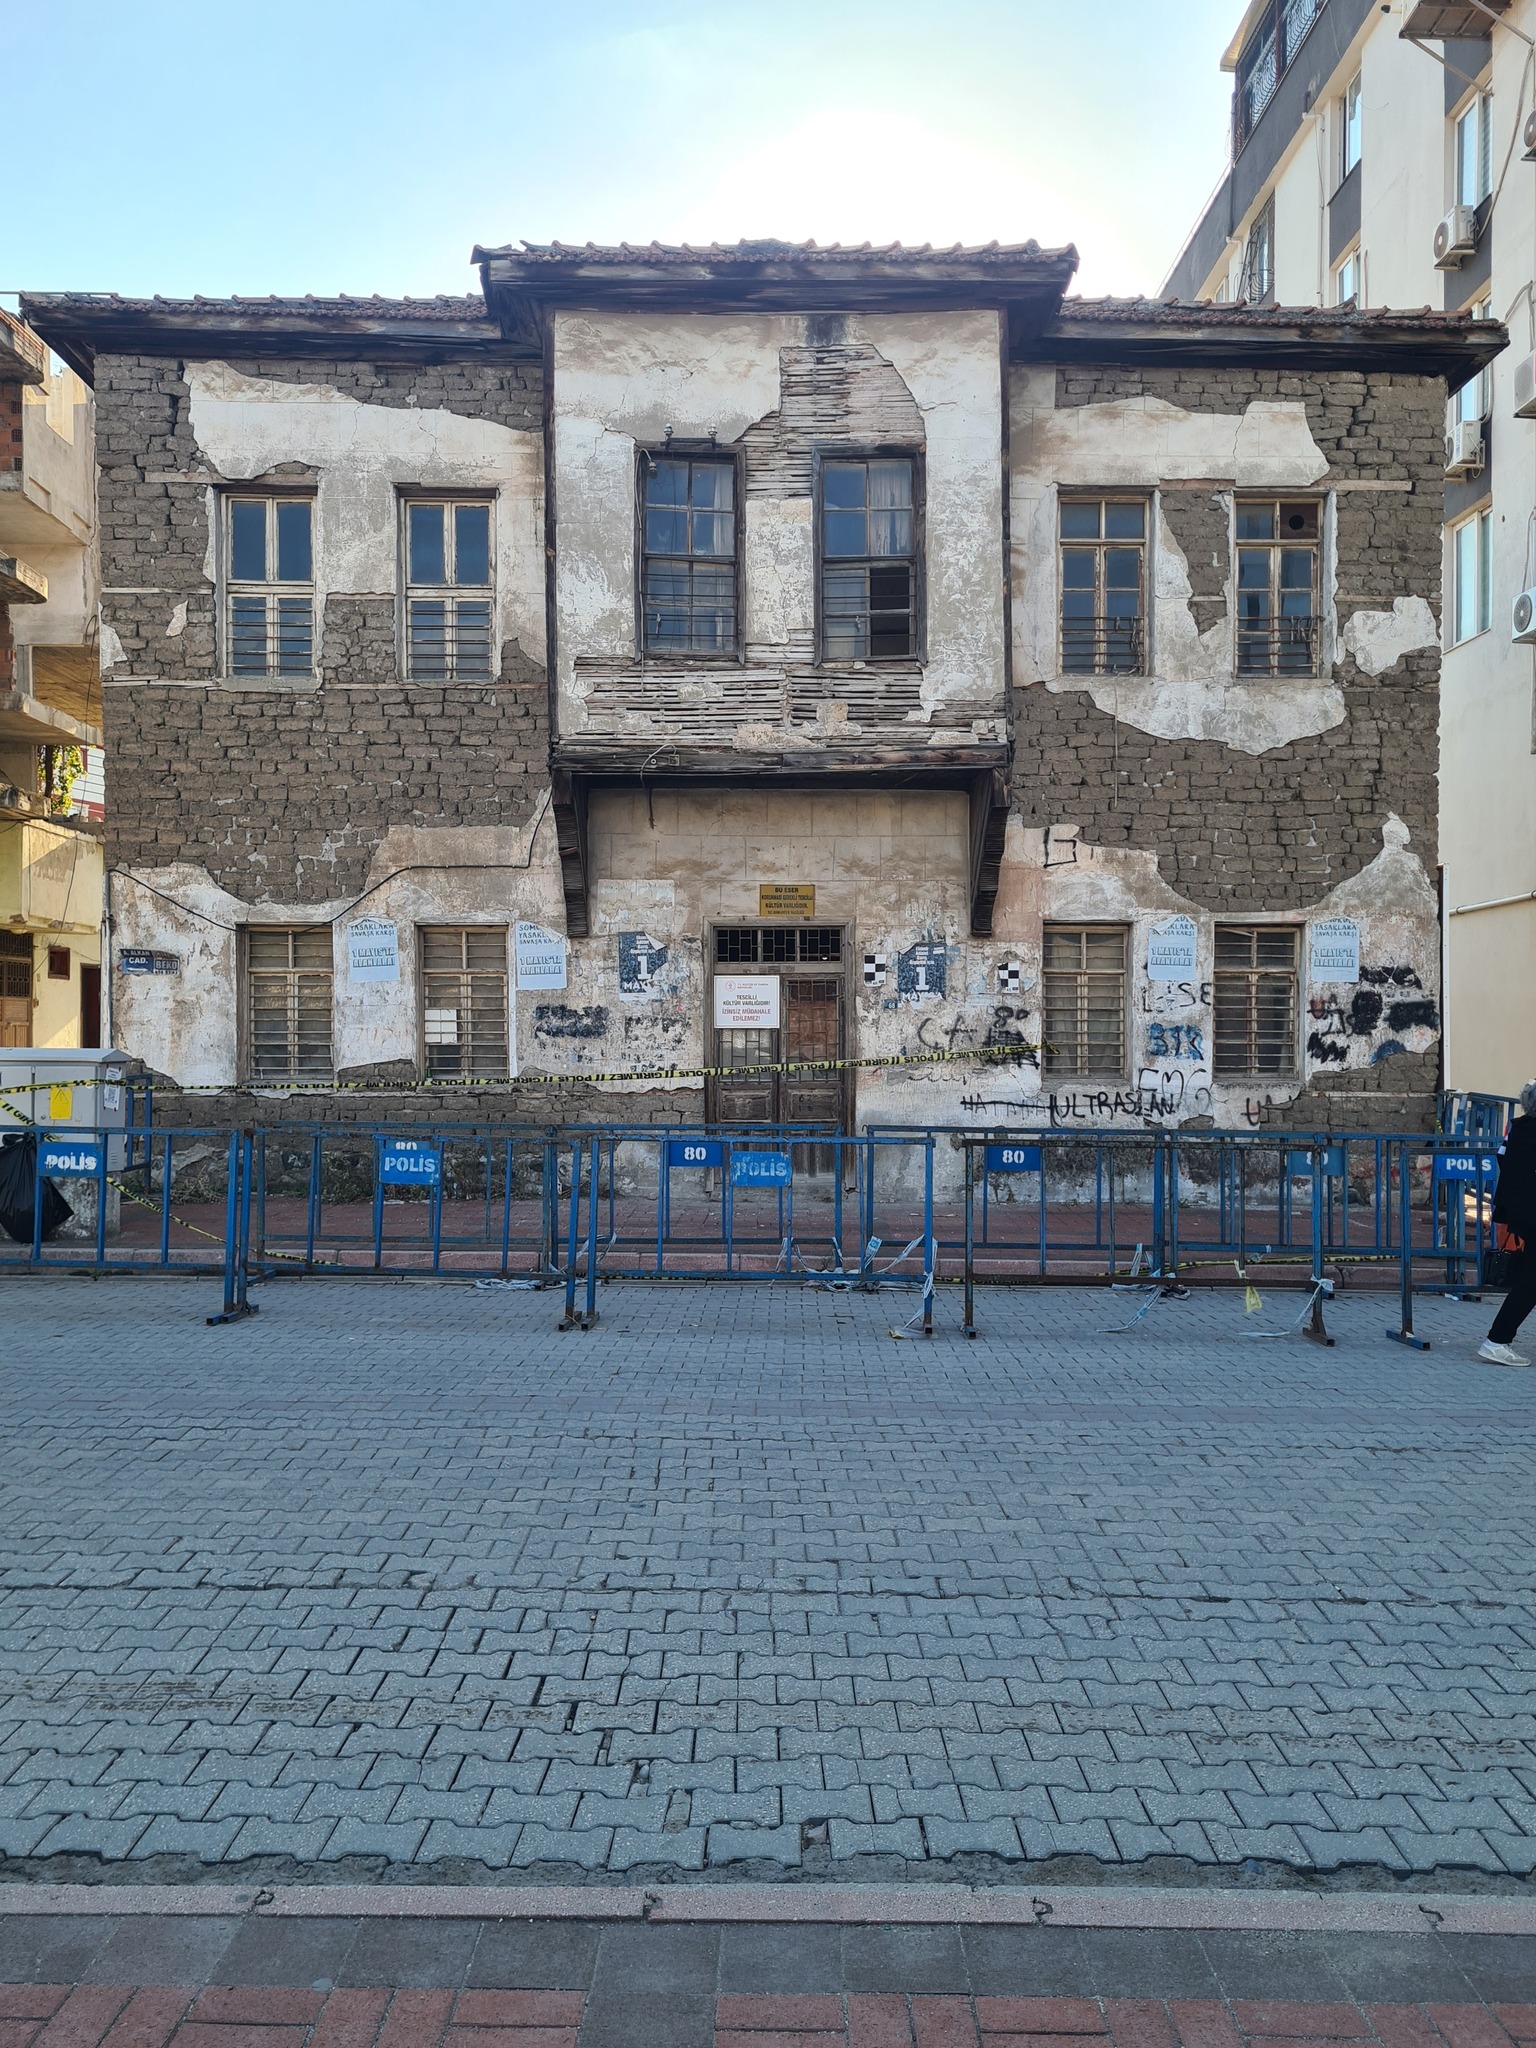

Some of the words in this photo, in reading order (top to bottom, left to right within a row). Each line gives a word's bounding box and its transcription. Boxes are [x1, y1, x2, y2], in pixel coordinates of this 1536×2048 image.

[156, 961, 178, 969] BEKO
[638, 956, 651, 979] 1
[916, 967, 929, 990] 1
[840, 1057, 889, 1068] GIRILMEZ
[904, 1054, 934, 1064] POLIS
[727, 1065, 778, 1075] GIRILMEZ
[794, 1063, 825, 1071] POLIS
[609, 1072, 662, 1081] GIRILMEZ
[678, 1069, 711, 1077] POLIS
[485, 1076, 540, 1084] GIRILMEZ
[558, 1075, 592, 1083] POLIS
[684, 1147, 707, 1160] 80
[1002, 1150, 1025, 1164] 80
[45, 1152, 97, 1171] POLİS
[384, 1154, 436, 1172] POLİS
[1446, 1158, 1492, 1171] POLS
[735, 1158, 787, 1177] POLİS
